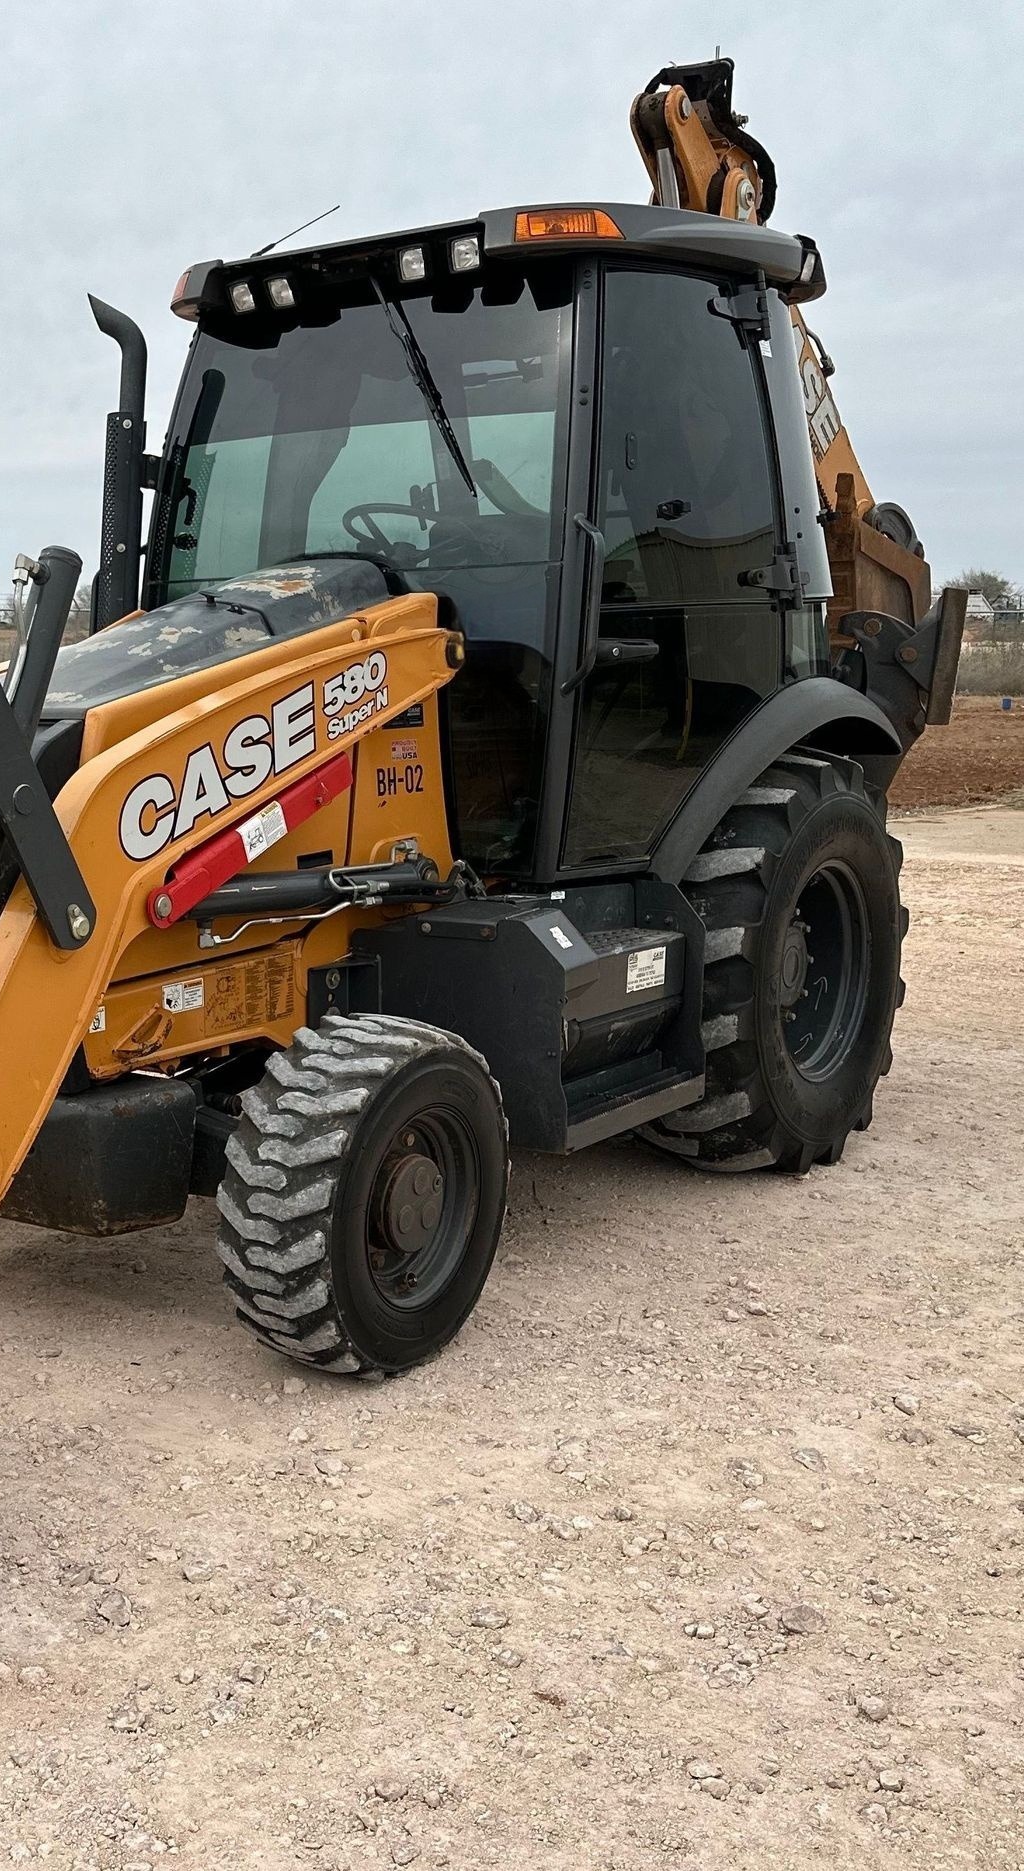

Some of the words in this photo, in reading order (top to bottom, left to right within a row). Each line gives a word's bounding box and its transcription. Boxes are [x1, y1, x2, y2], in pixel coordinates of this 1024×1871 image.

[323, 650, 388, 716] 580
[328, 699, 375, 740] Super
[374, 686, 389, 711] N
[119, 680, 317, 862] CASE
[377, 765, 424, 797] BH-02
[402, 752, 418, 760] USA
